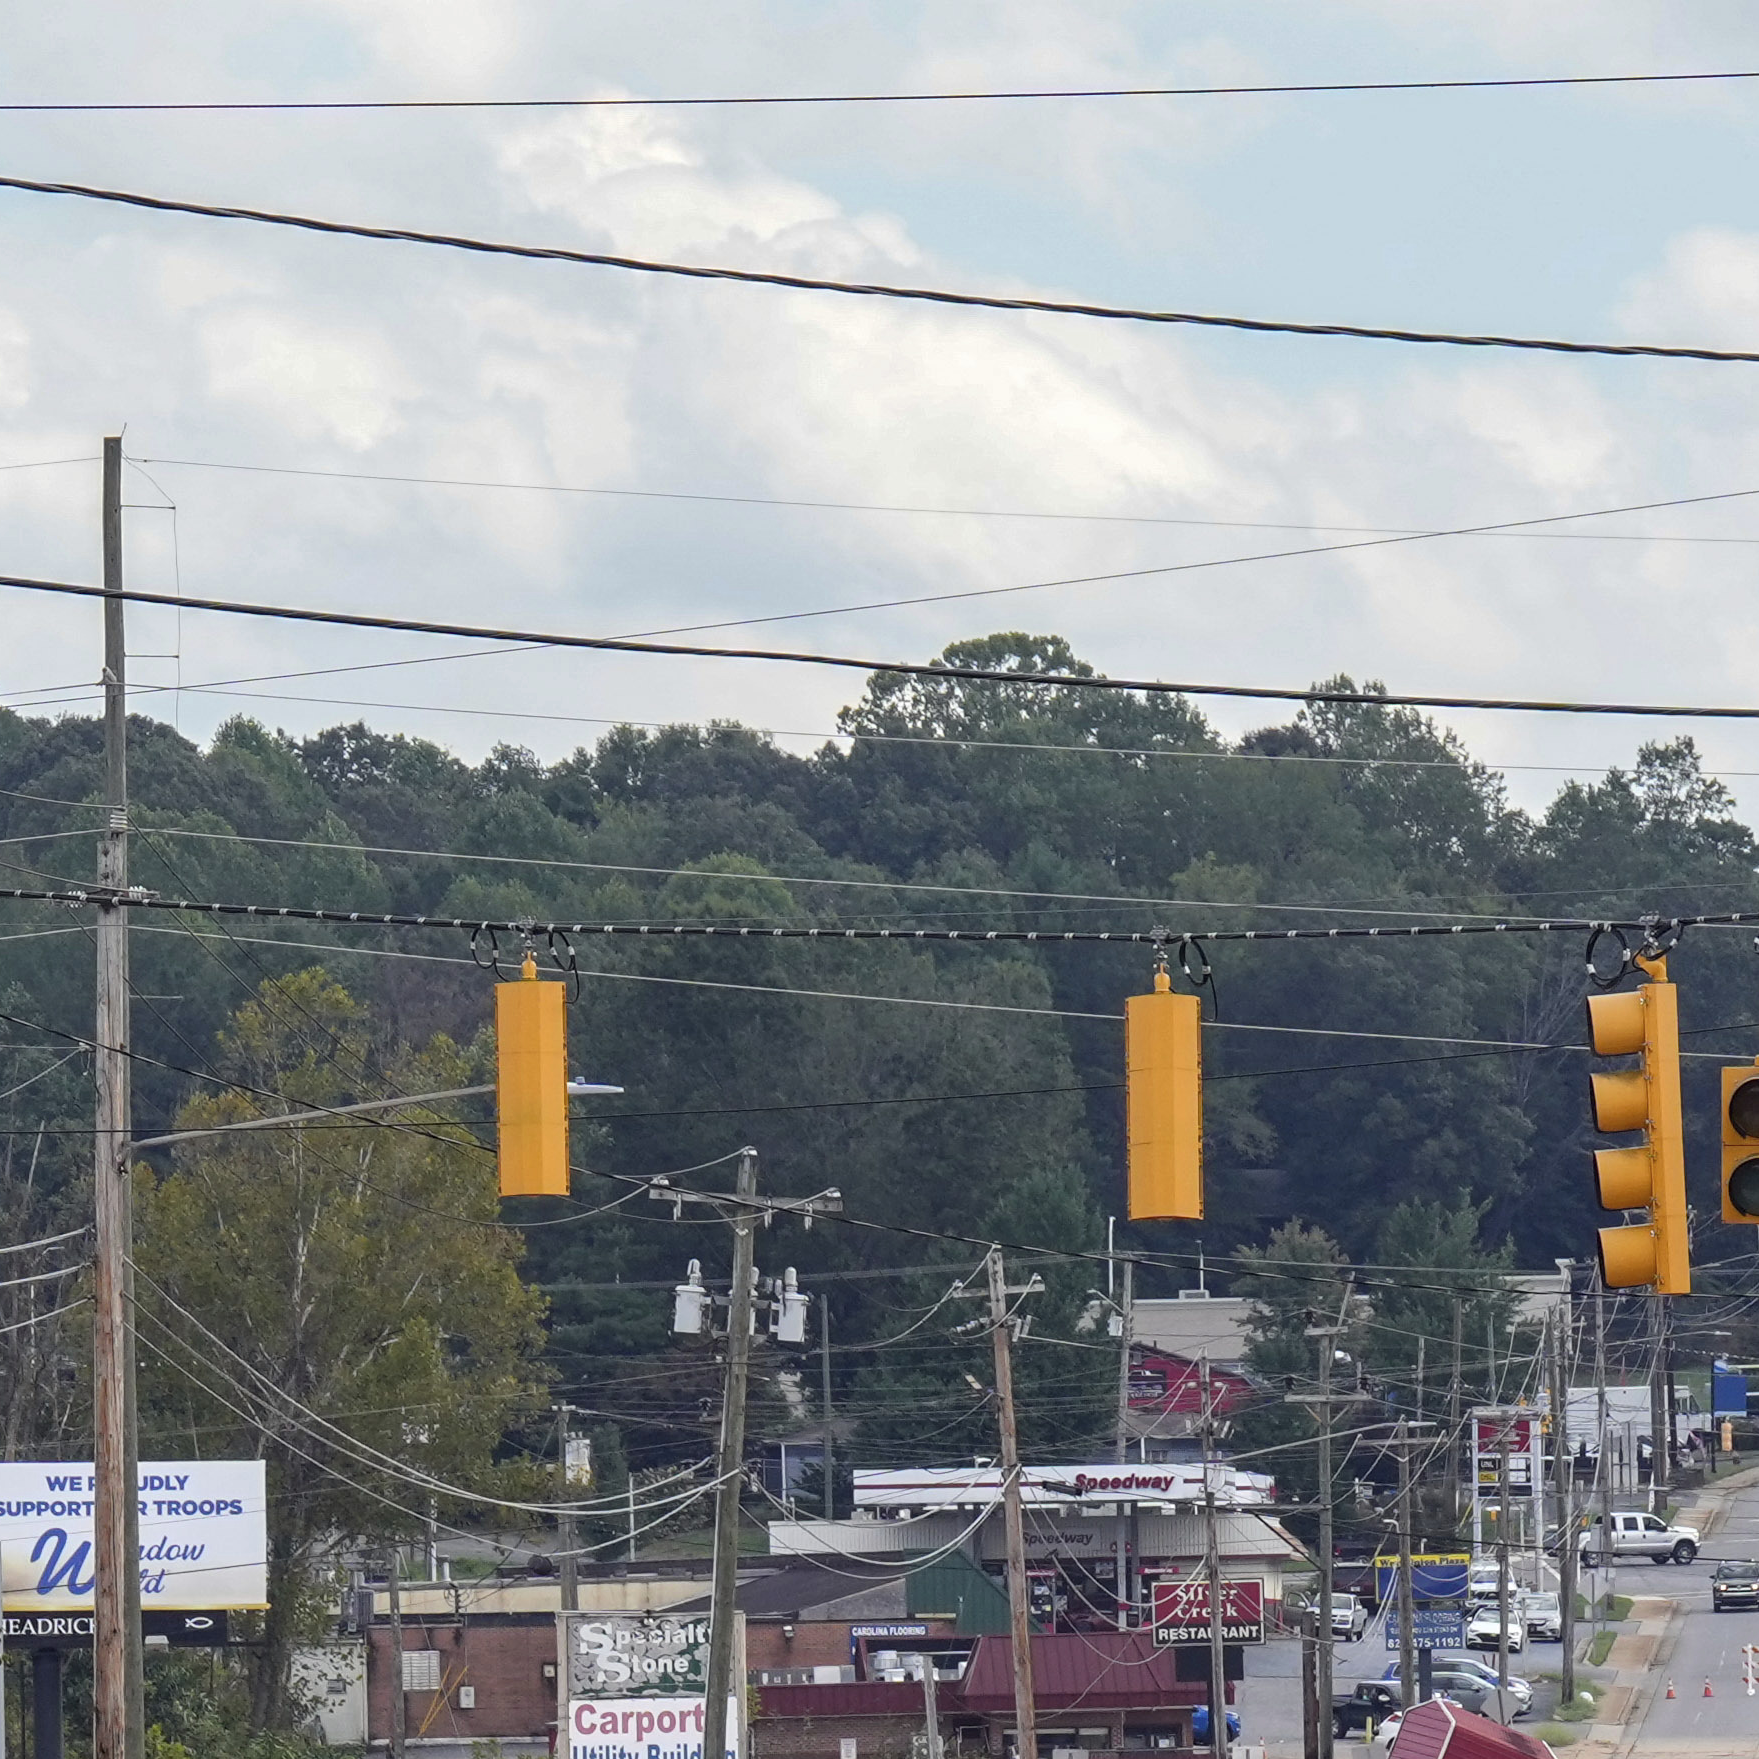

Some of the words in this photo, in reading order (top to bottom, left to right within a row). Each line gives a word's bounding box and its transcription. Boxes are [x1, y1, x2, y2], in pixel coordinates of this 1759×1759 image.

[46, 1476, 82, 1491] WE
[88, 1475, 189, 1491] PUDLY
[1075, 1473, 1174, 1491] Speedway
[156, 1500, 243, 1515] TROOPS
[1023, 1532, 1092, 1544] Speedway
[1177, 1603, 1238, 1618] Crek
[852, 1627, 888, 1636] CAROLINA
[890, 1627, 926, 1635] FLOORING
[596, 1651, 689, 1683] Stone
